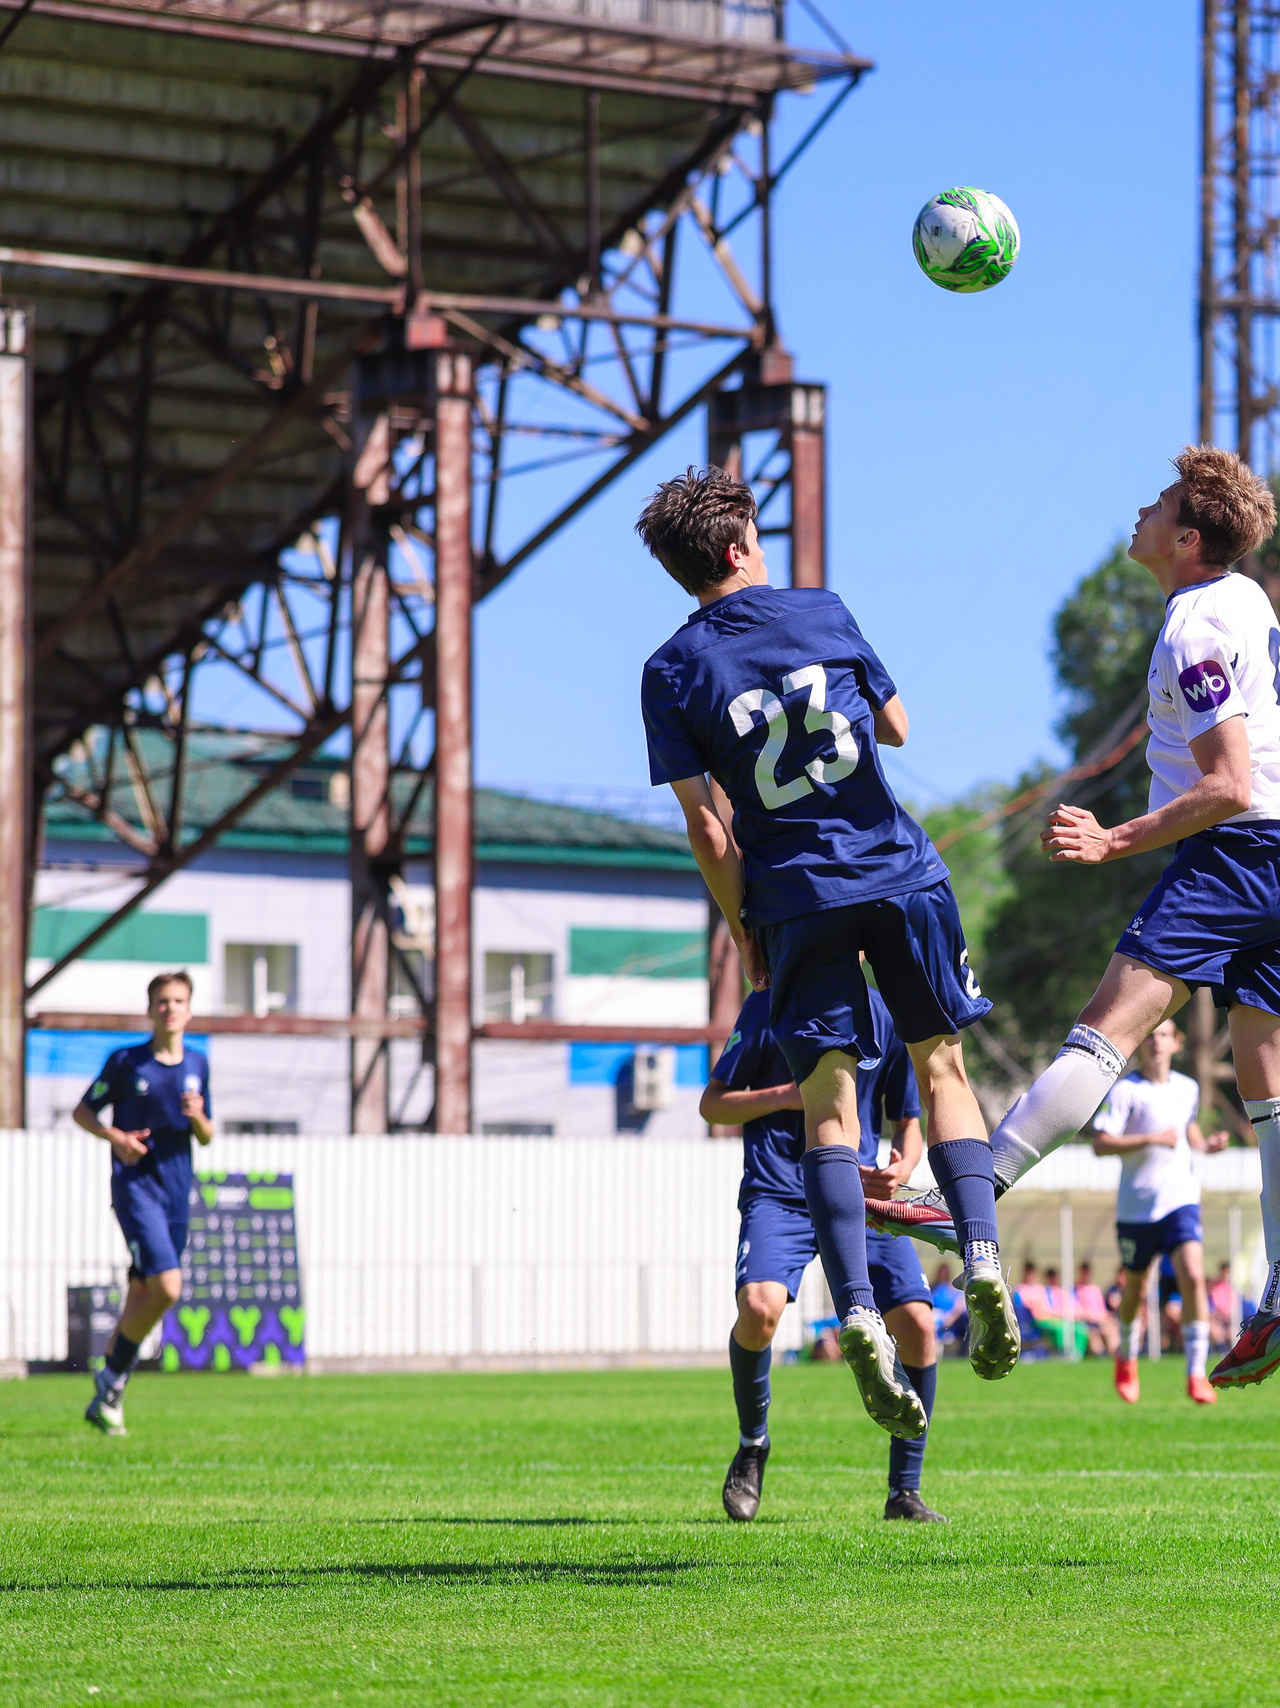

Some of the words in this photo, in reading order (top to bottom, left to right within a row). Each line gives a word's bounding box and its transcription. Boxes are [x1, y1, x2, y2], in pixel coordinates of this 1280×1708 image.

[728, 663, 859, 810] 23
[959, 947, 982, 1000] 2
[1264, 1260, 1280, 1311] TAPEDESIGN
